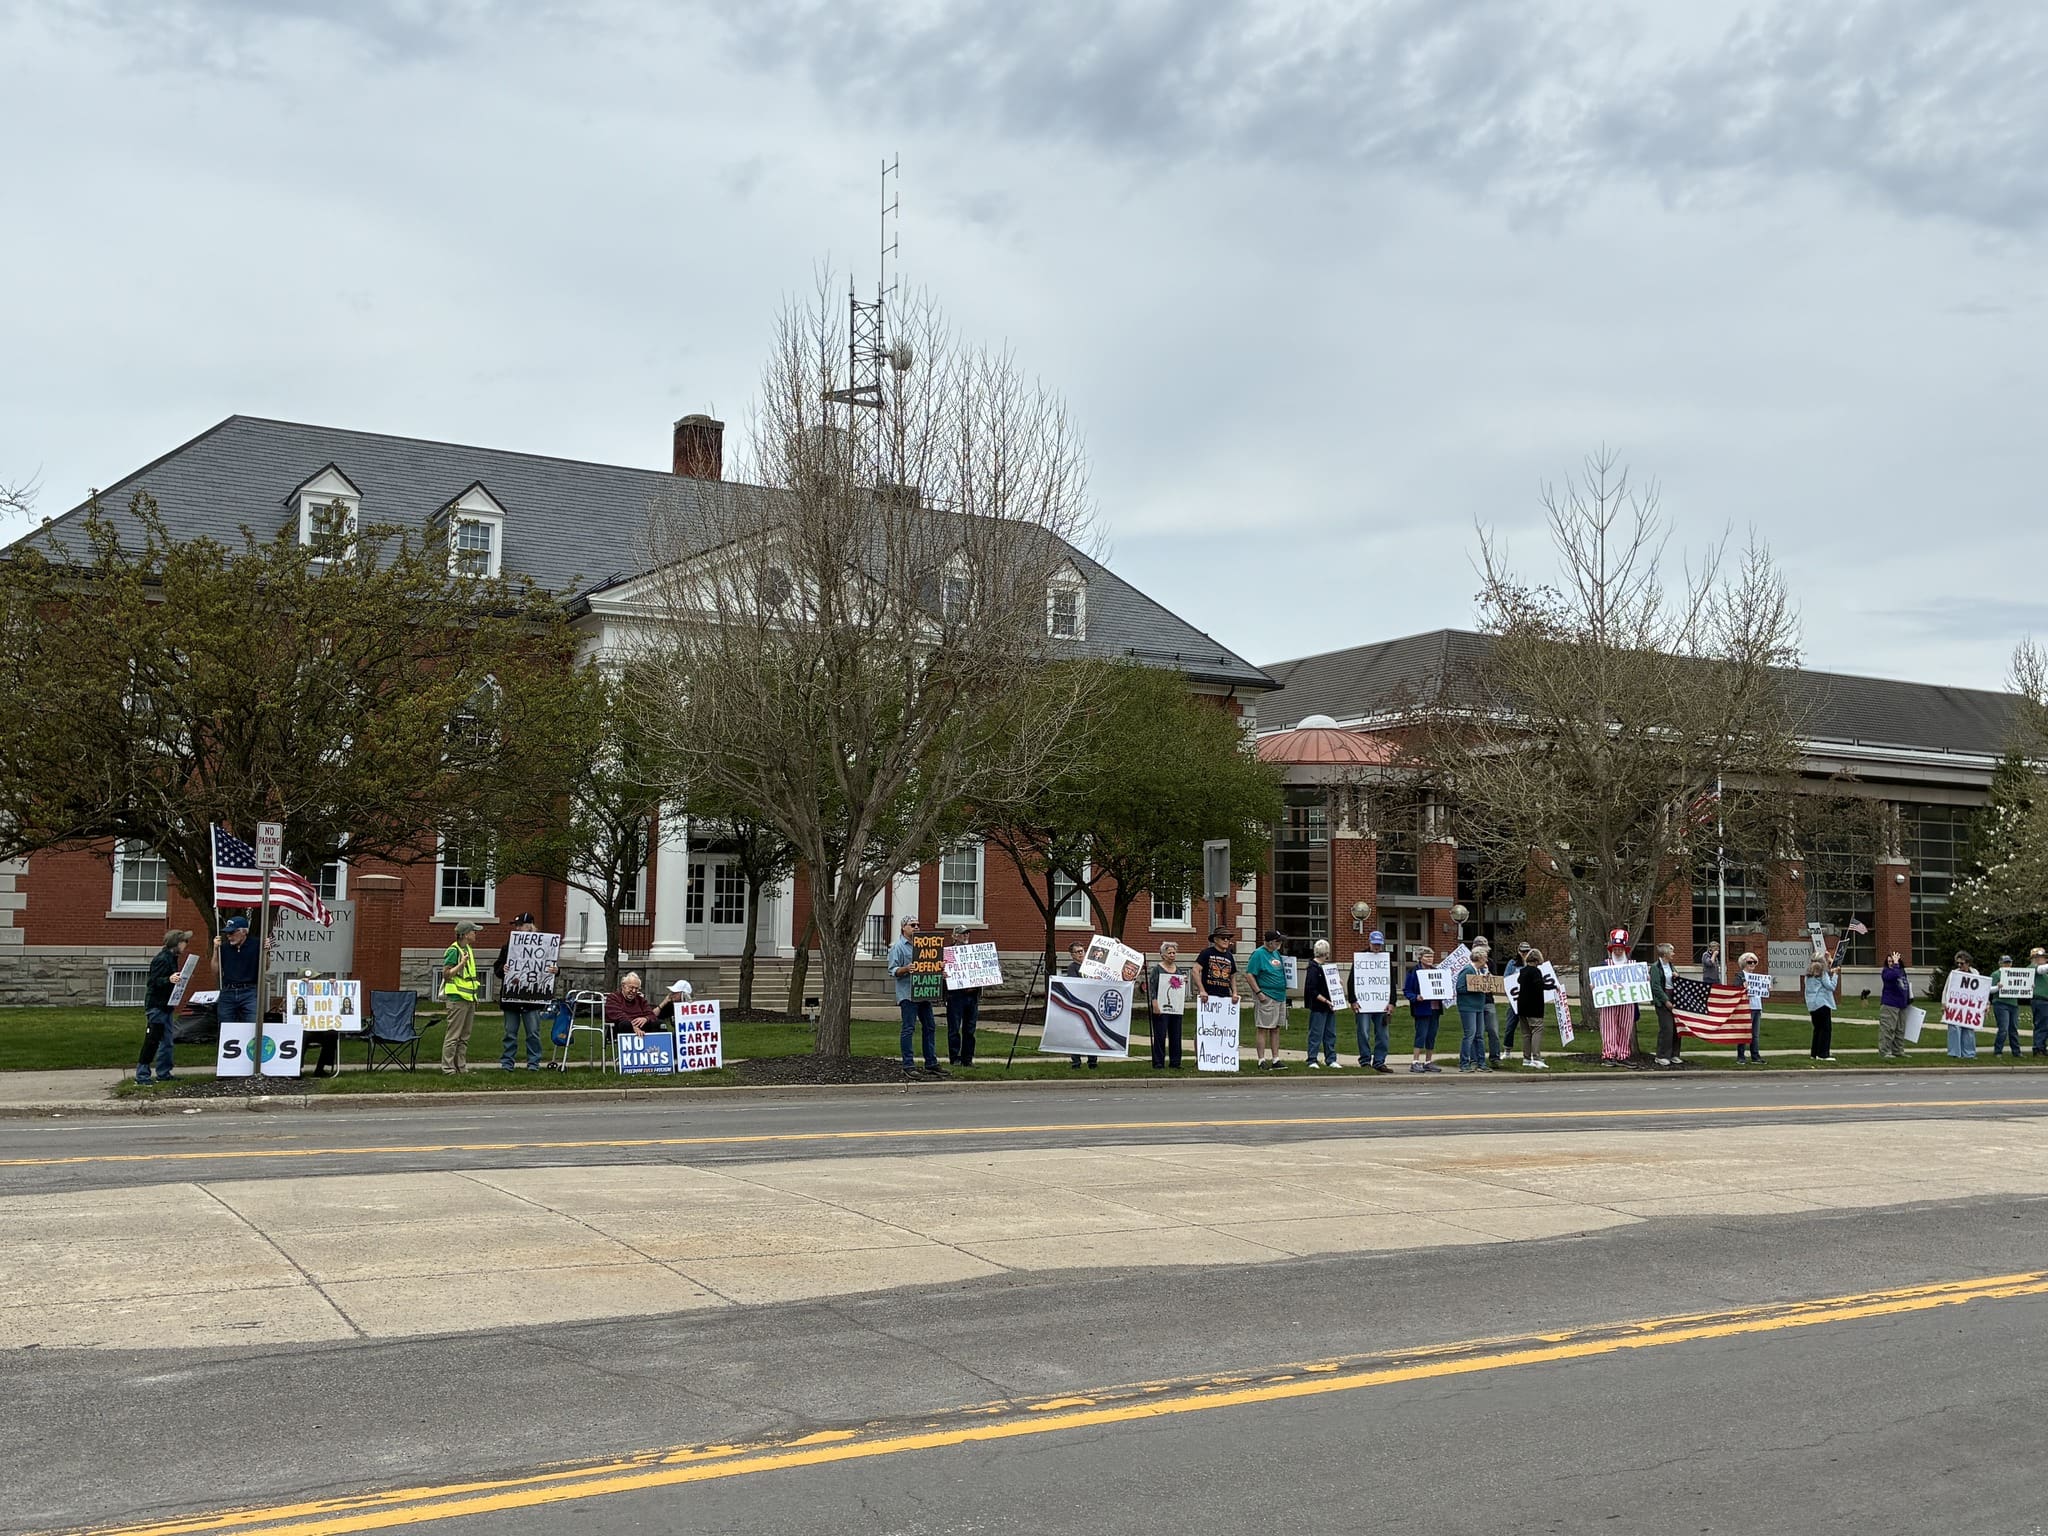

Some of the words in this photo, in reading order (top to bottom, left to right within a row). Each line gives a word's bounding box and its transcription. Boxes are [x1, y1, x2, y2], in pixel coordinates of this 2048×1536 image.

[264, 827, 275, 836] NO
[259, 837, 280, 846] PARKING
[512, 933, 544, 946] THERE
[550, 935, 559, 947] IS
[914, 937, 944, 948] PROTECT
[522, 947, 545, 959] NO
[919, 949, 938, 959] AND
[1453, 946, 1466, 959] NOT
[508, 960, 557, 973] PLANET
[914, 961, 943, 972] DEFEND
[948, 961, 982, 971] POLITICAL
[1355, 961, 1388, 970] SCIENCE
[527, 971, 538, 982] B
[913, 975, 942, 986] PLANET
[1356, 977, 1365, 985] IS
[290, 982, 357, 996] COMMUNITY
[1960, 976, 1979, 990] NO
[914, 987, 940, 998] EARTH
[1371, 992, 1389, 1001] TRUE
[1595, 983, 1651, 1006] GREEN
[314, 998, 332, 1012] not
[1949, 992, 1984, 1009] HOLY
[681, 1004, 714, 1015] MEGA
[1228, 1004, 1236, 1015] is
[301, 1015, 342, 1029] CAGES
[1945, 1007, 1981, 1026] WARS
[679, 1021, 711, 1032] MAKE
[1198, 1015, 1236, 1048] destroying
[621, 1036, 645, 1051] NO
[680, 1032, 718, 1044] EARTH
[680, 1044, 717, 1056] GREAT
[1199, 1042, 1236, 1065] America
[623, 1052, 669, 1066] KINGS
[680, 1057, 717, 1069] AGAIN
